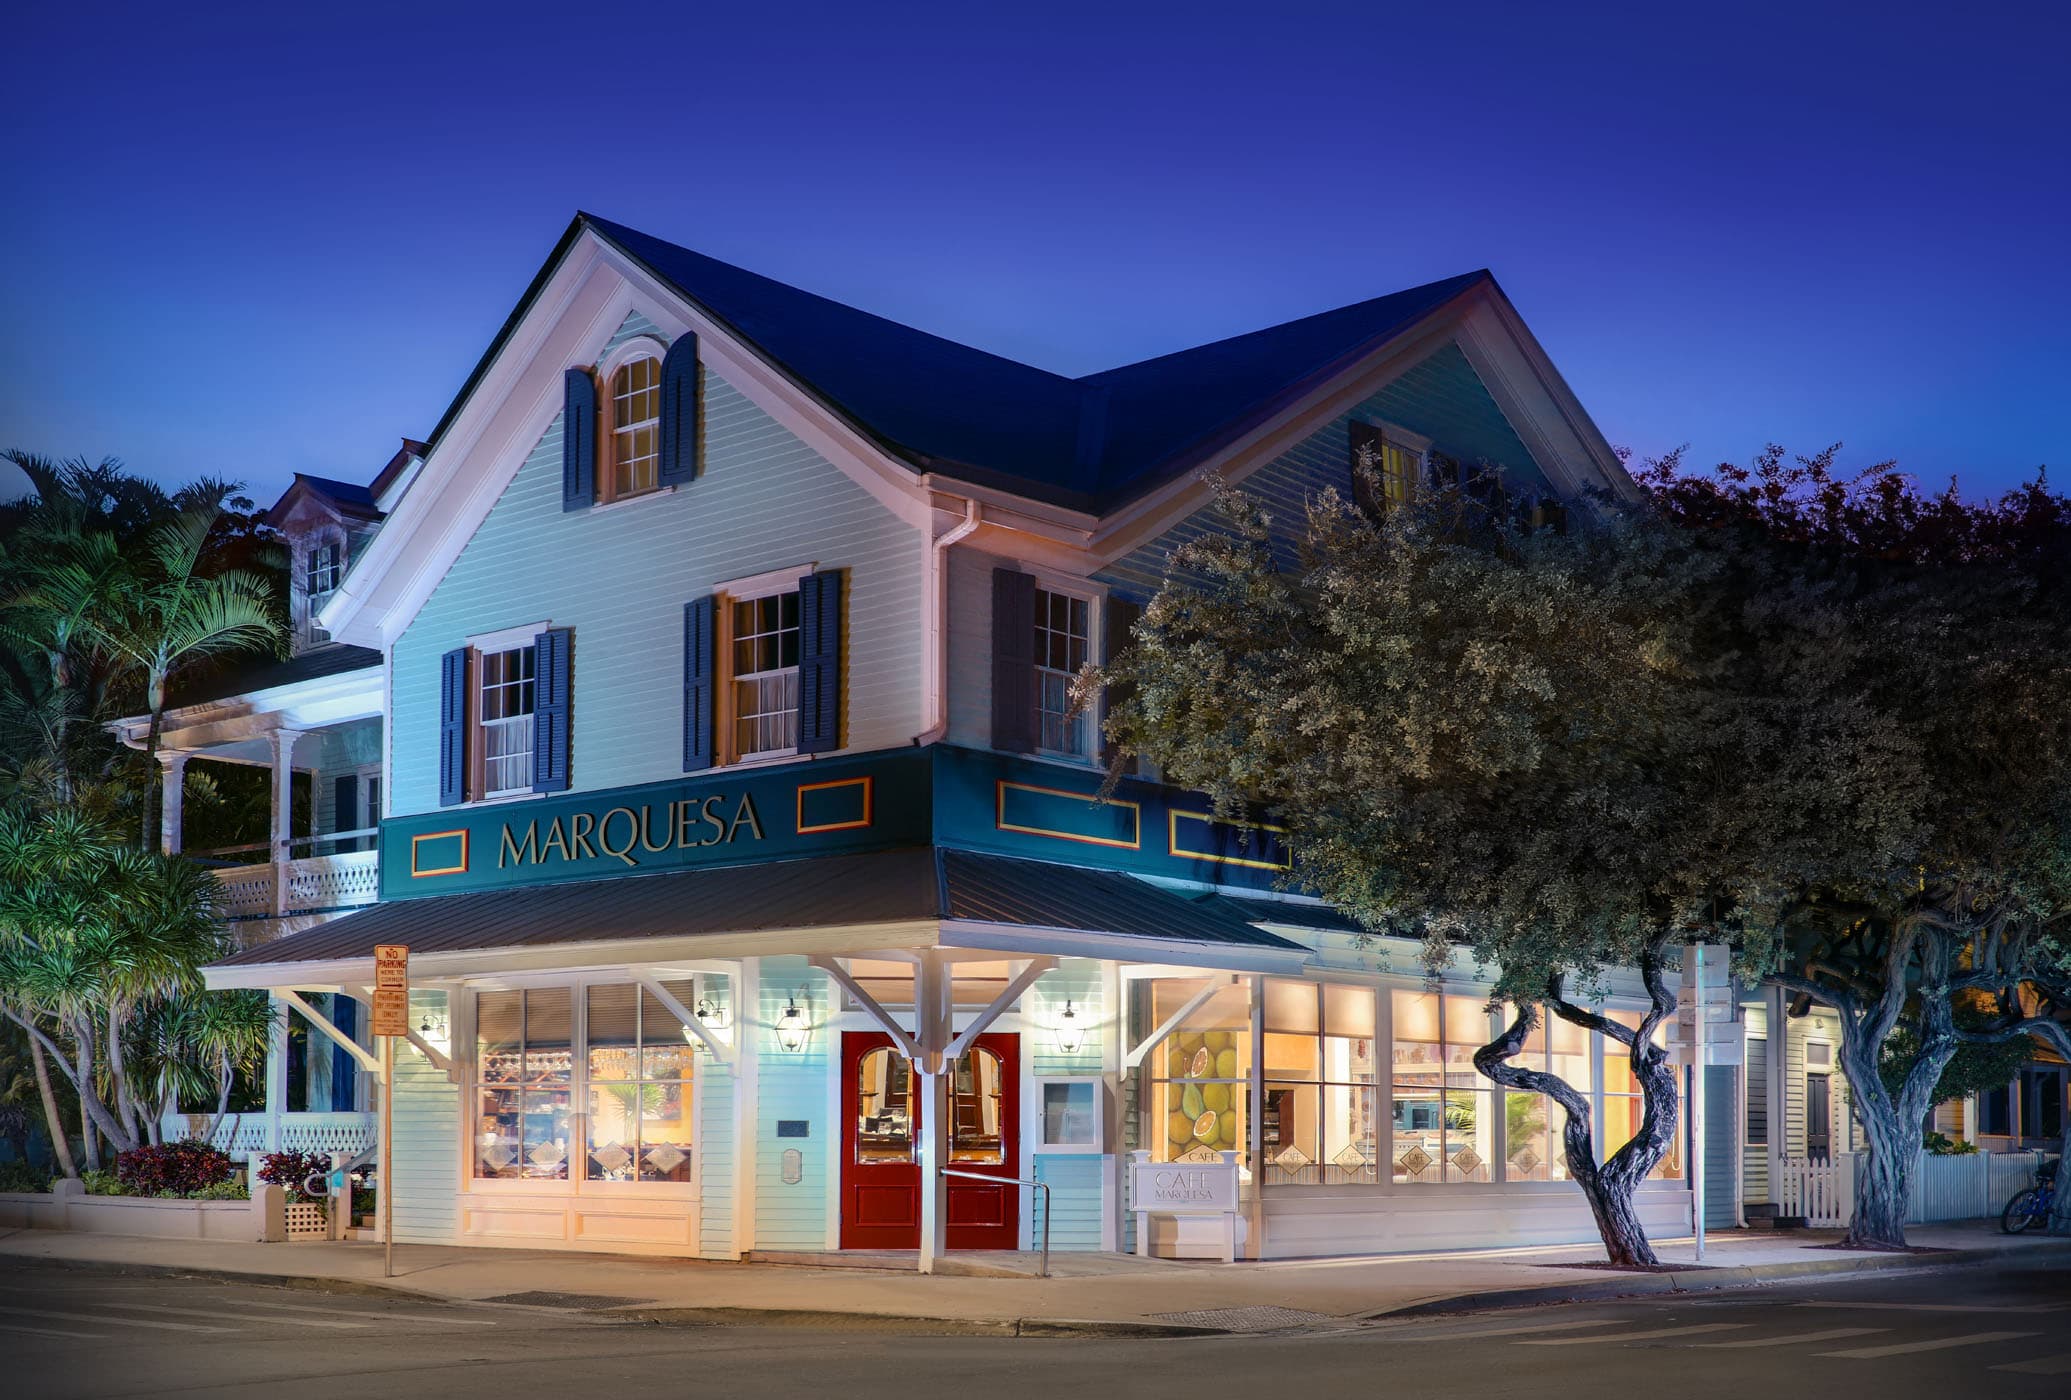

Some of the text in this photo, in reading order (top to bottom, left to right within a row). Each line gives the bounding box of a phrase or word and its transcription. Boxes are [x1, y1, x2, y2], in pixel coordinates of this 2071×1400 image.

[499, 793, 764, 868] MARQUESA
[385, 950, 398, 959] NO
[377, 960, 406, 968] PARKING
[1154, 1190, 1213, 1200] MARQUESA
